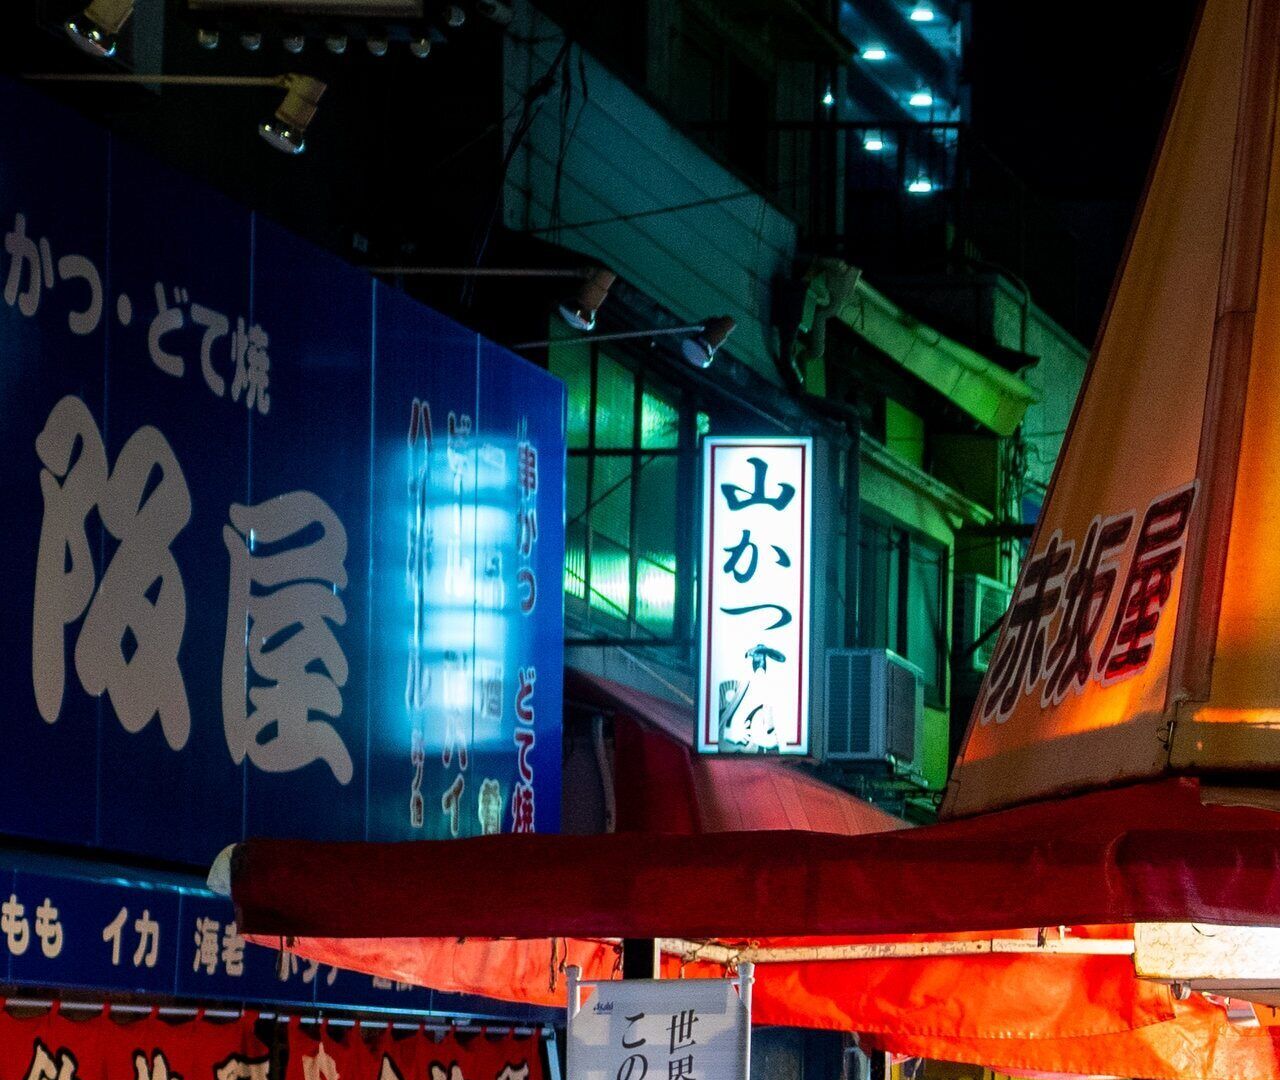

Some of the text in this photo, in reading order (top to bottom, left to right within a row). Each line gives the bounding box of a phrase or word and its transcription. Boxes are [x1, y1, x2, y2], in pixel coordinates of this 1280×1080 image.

[4, 212, 271, 415] かつ・どて焼
[981, 479, 1200, 725] 赤坂屋
[1, 893, 63, 958] もも
[103, 906, 160, 968] イカ
[194, 916, 245, 977] 海老
